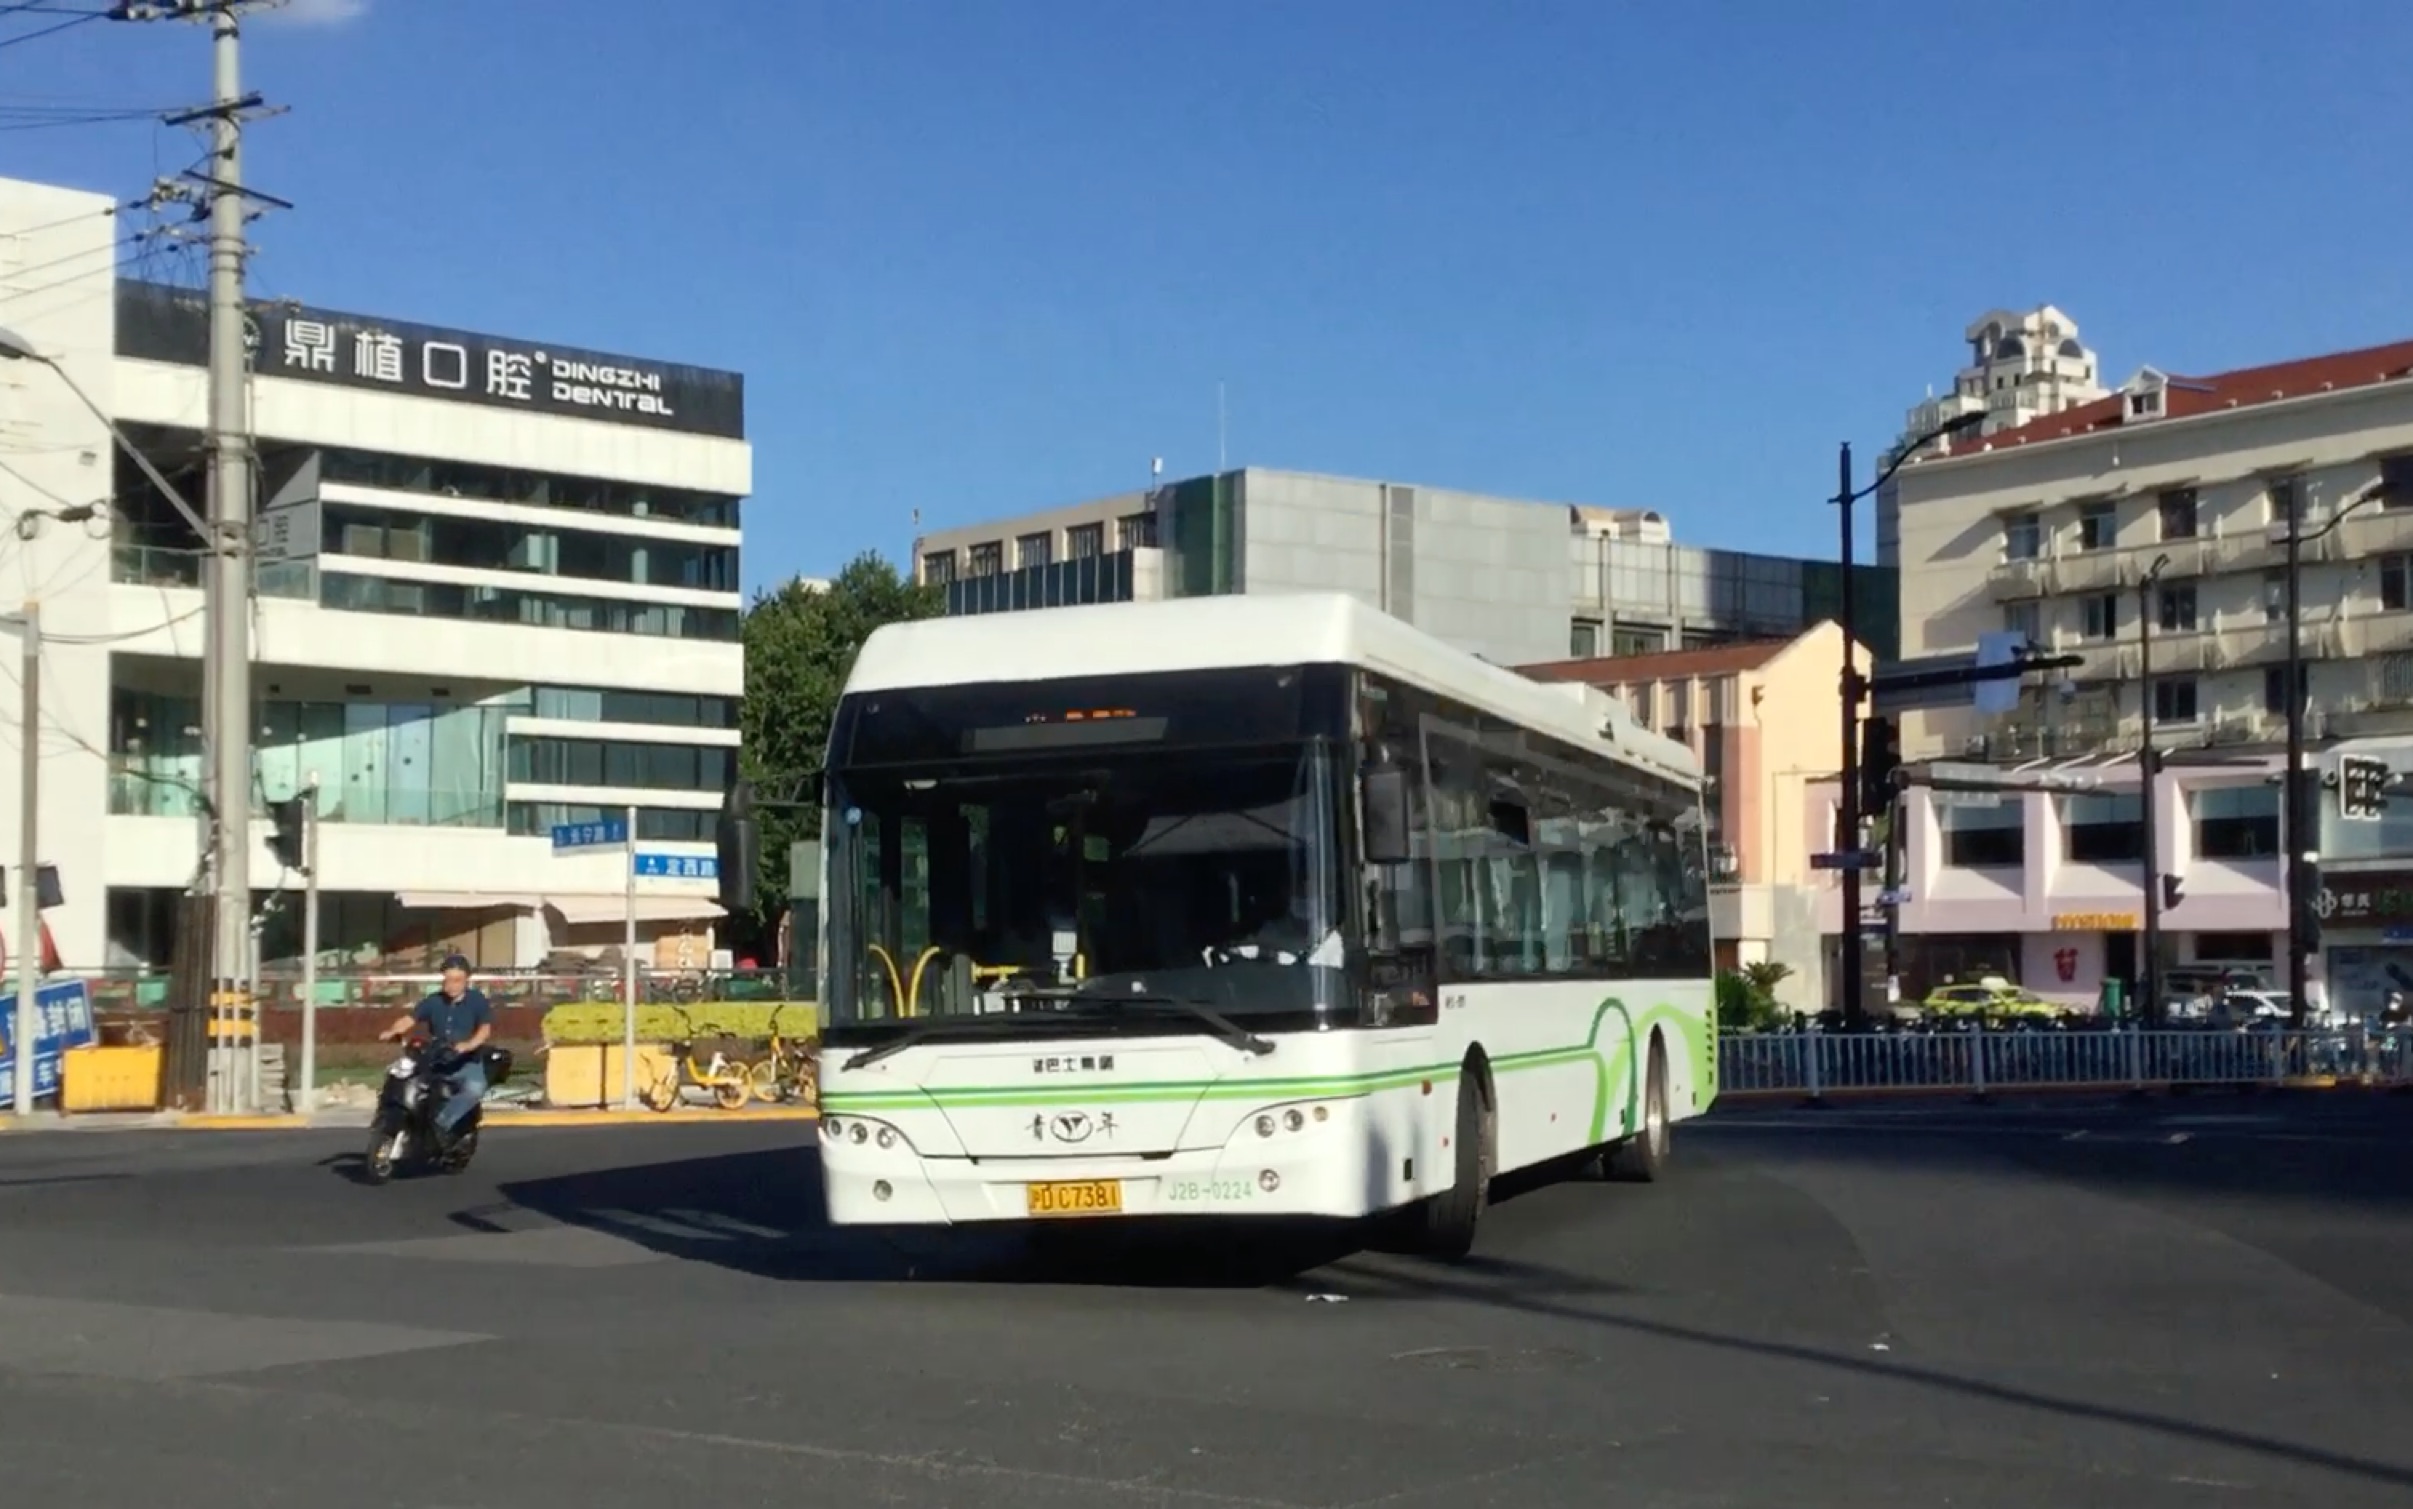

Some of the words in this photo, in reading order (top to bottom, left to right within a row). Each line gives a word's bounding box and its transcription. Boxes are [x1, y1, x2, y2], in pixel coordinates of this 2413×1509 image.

[285, 318, 532, 400] 鼎植口腔
[552, 359, 661, 392] DINGZHI
[1168, 1181, 1253, 1201] J2B-0224
